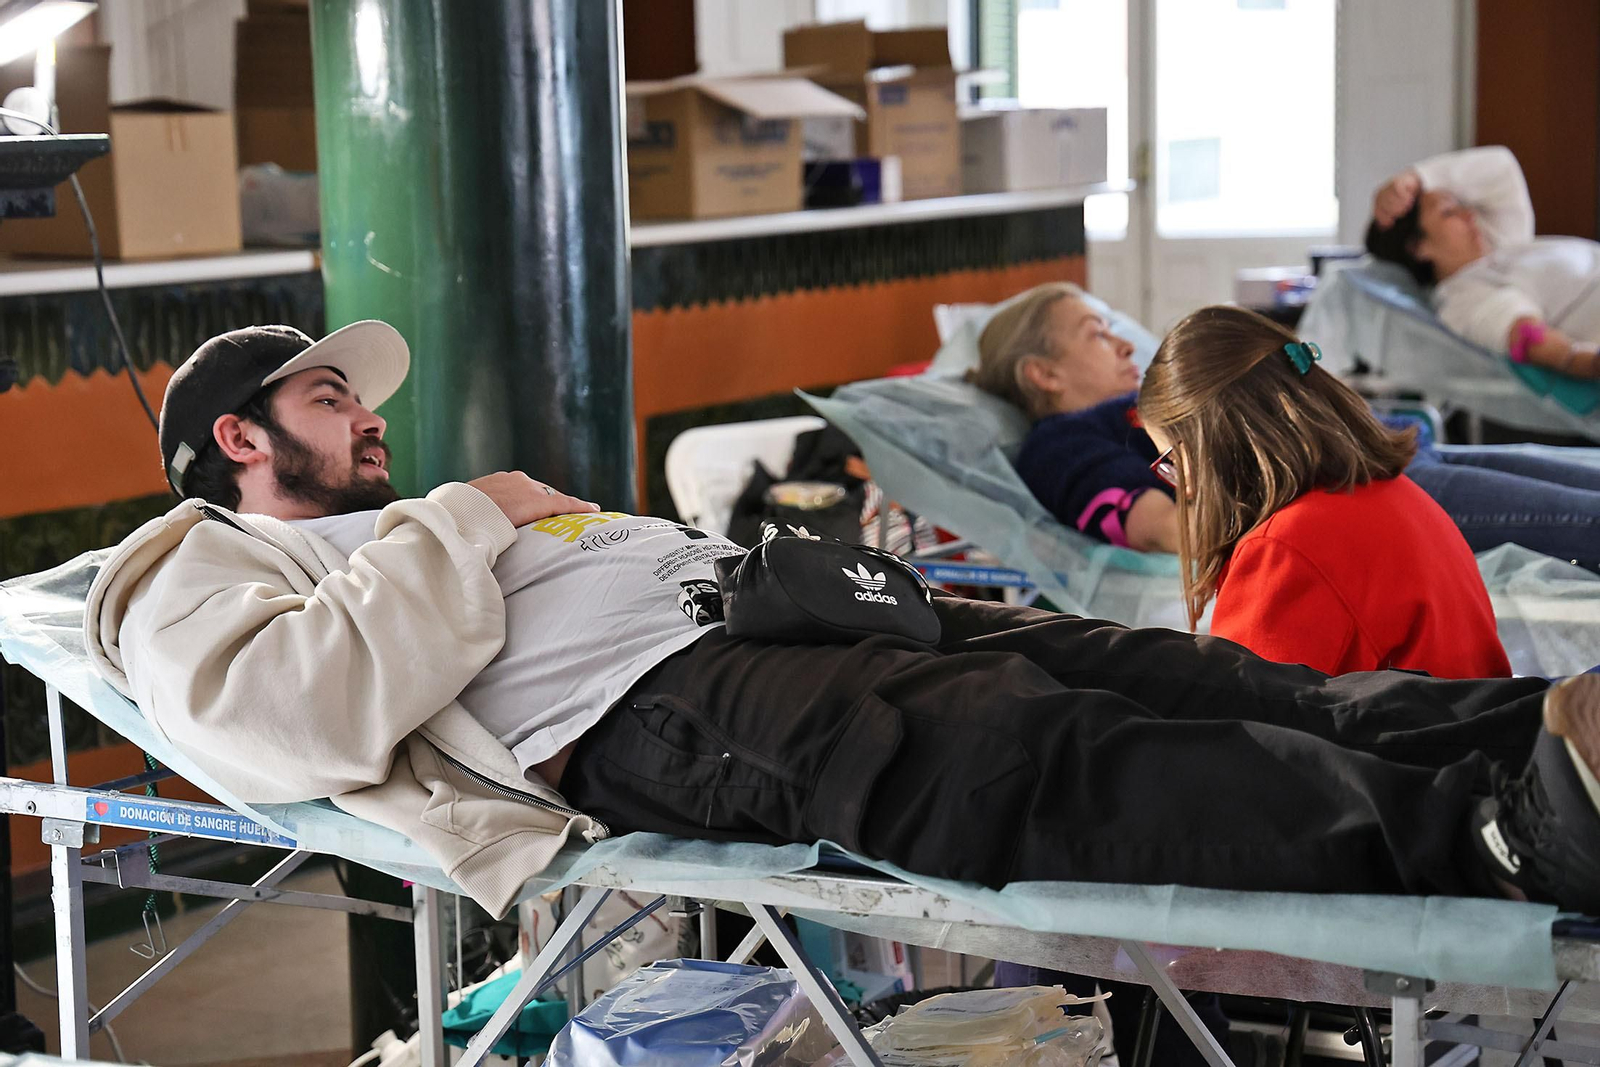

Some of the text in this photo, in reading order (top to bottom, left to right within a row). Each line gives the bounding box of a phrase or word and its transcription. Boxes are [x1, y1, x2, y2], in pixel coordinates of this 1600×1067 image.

[653, 556, 680, 577] DIFFERENT
[854, 590, 898, 606] adidas
[177, 812, 192, 826] DE
[194, 815, 237, 833] SANGRE
